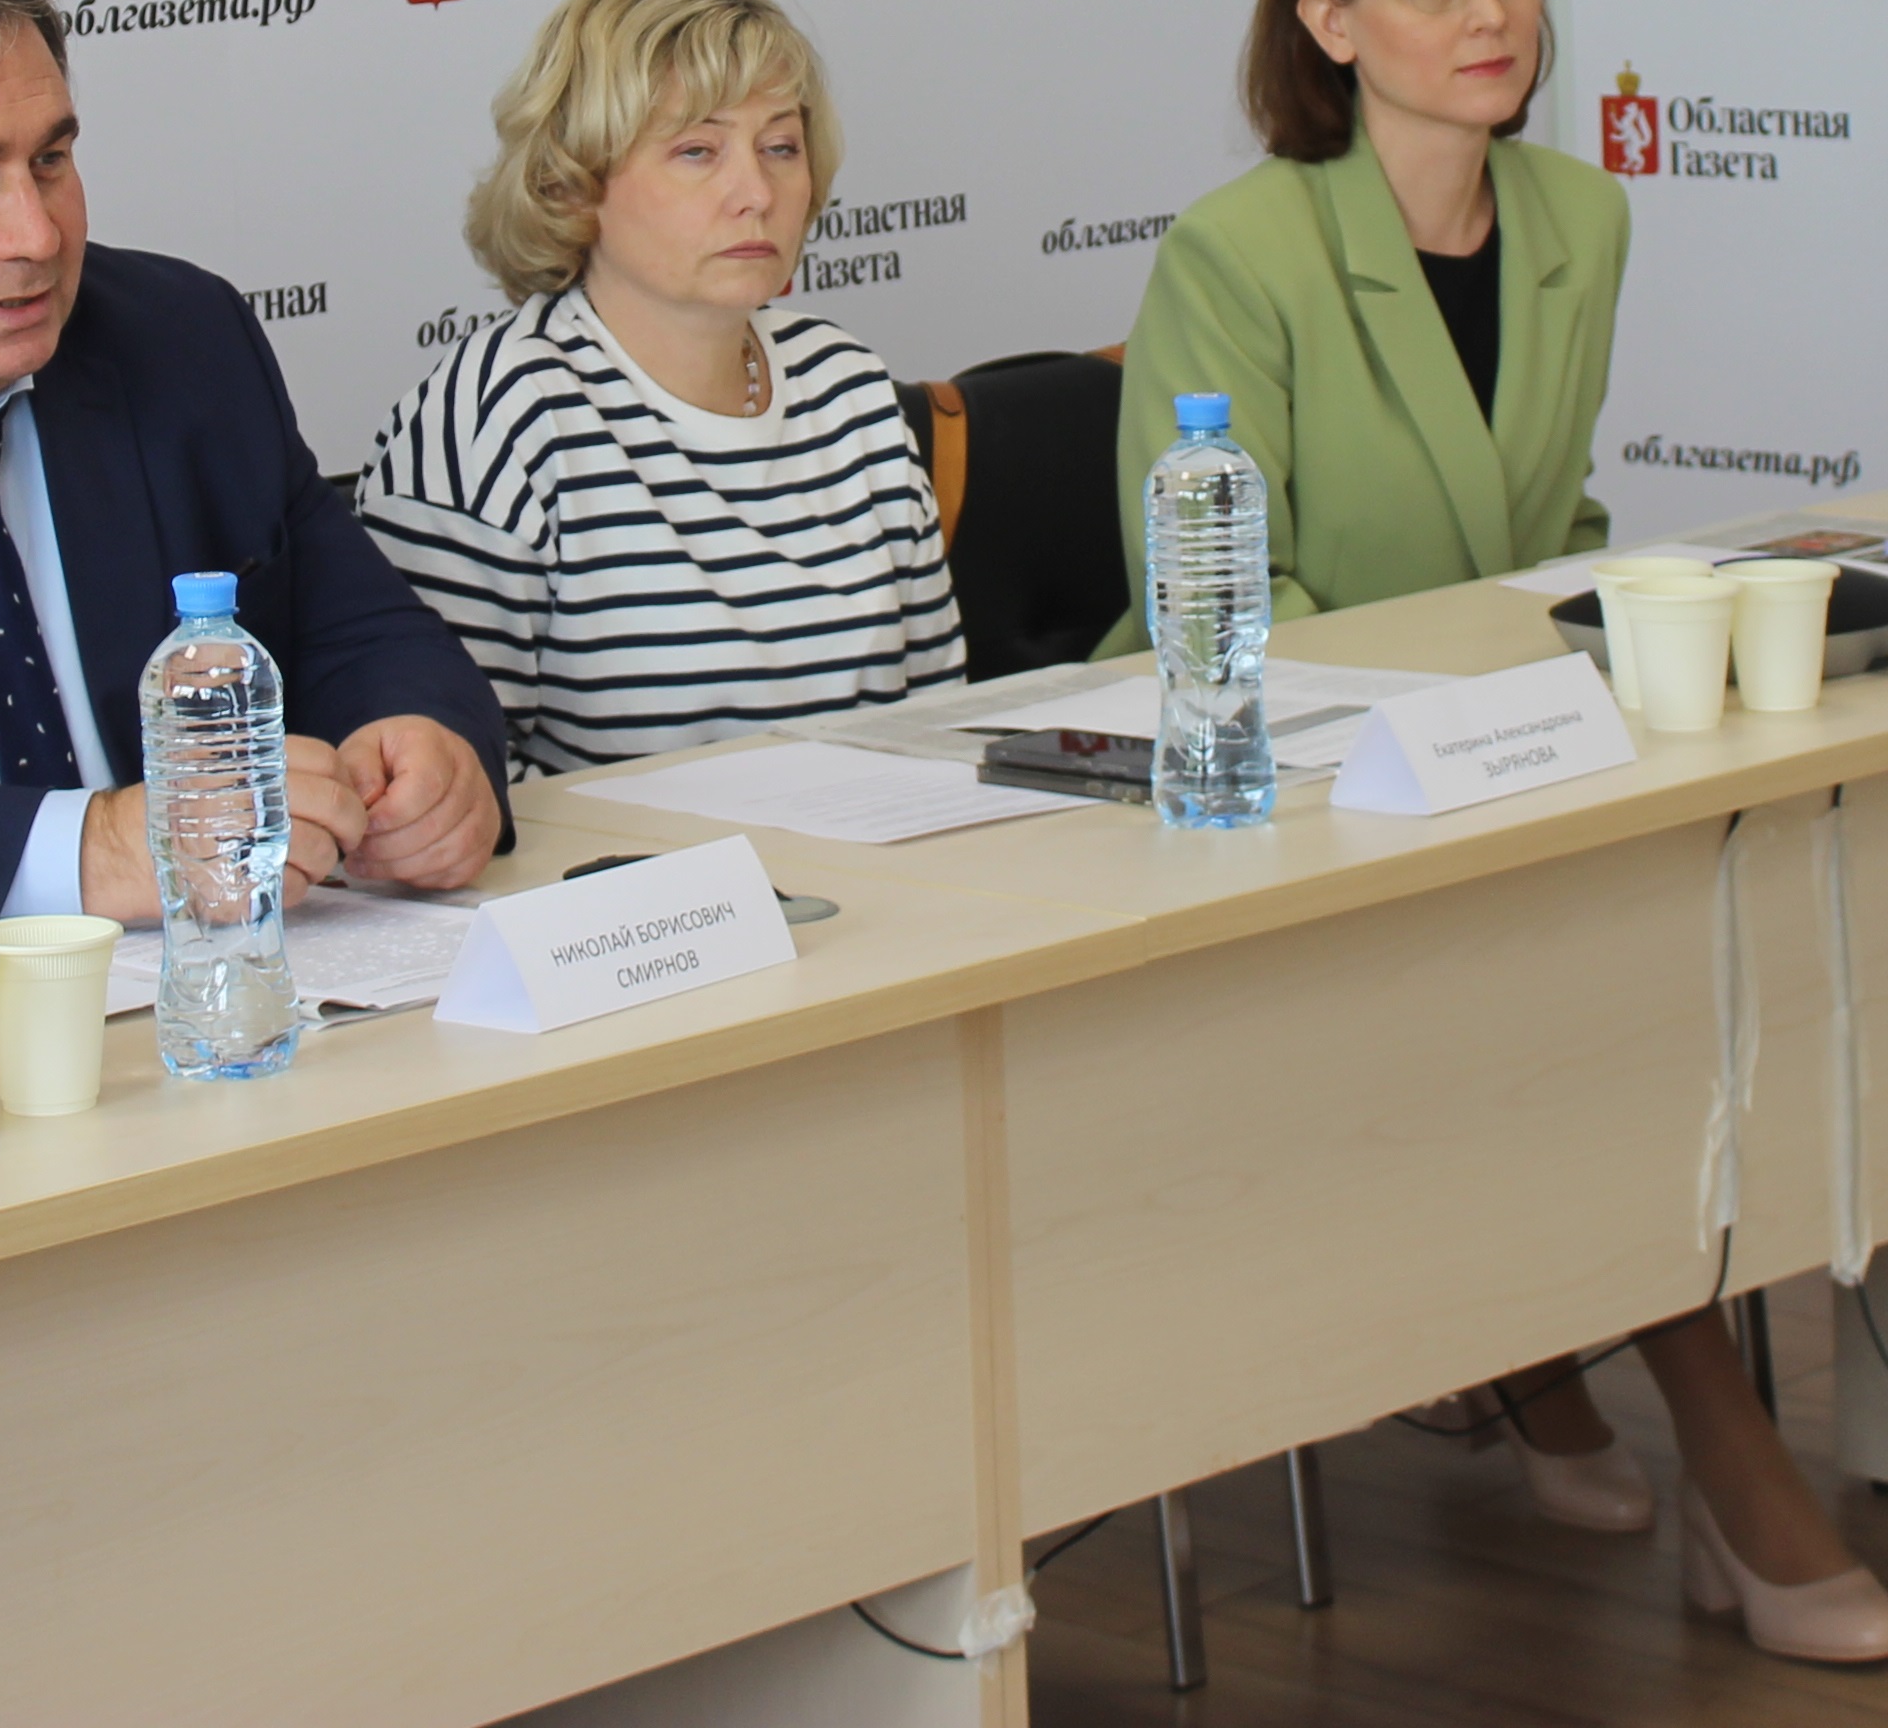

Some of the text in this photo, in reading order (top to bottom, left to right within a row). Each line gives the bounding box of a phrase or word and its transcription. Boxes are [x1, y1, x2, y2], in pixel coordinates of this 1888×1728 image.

[1667, 96, 1850, 139] Областная
[1668, 142, 1778, 181] Газета
[1041, 213, 1176, 255] облгазет
[802, 249, 901, 293] Газета
[1623, 435, 1861, 487] облгазета.рф
[1482, 745, 1560, 779] ЗЫРЯНОВА
[550, 902, 736, 967] НИКОЛАЙ БОРИСОВИЧ
[617, 949, 700, 989] СМИРНОВ
